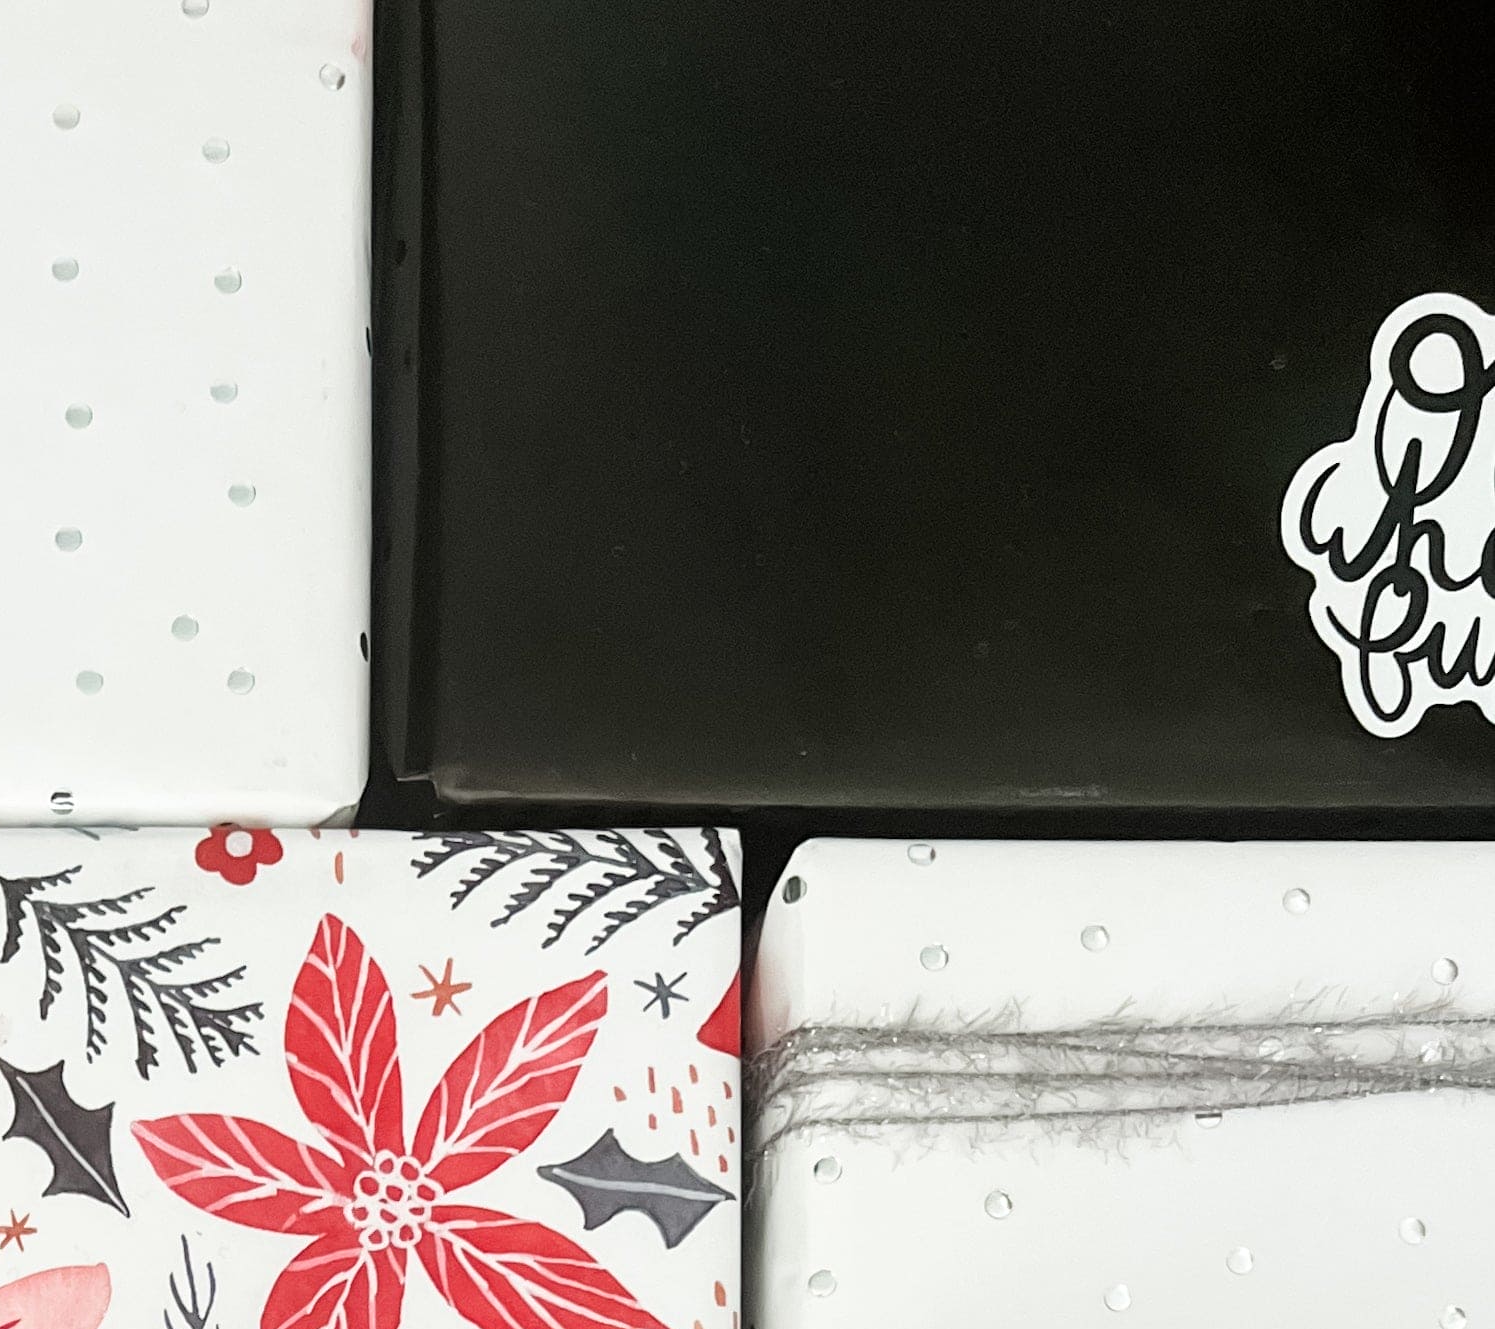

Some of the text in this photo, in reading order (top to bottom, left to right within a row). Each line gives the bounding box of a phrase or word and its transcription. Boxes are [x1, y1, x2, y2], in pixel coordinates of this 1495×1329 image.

[1374, 313, 1495, 506] O
[1300, 438, 1495, 598] wh
[1326, 565, 1495, 722] fu
